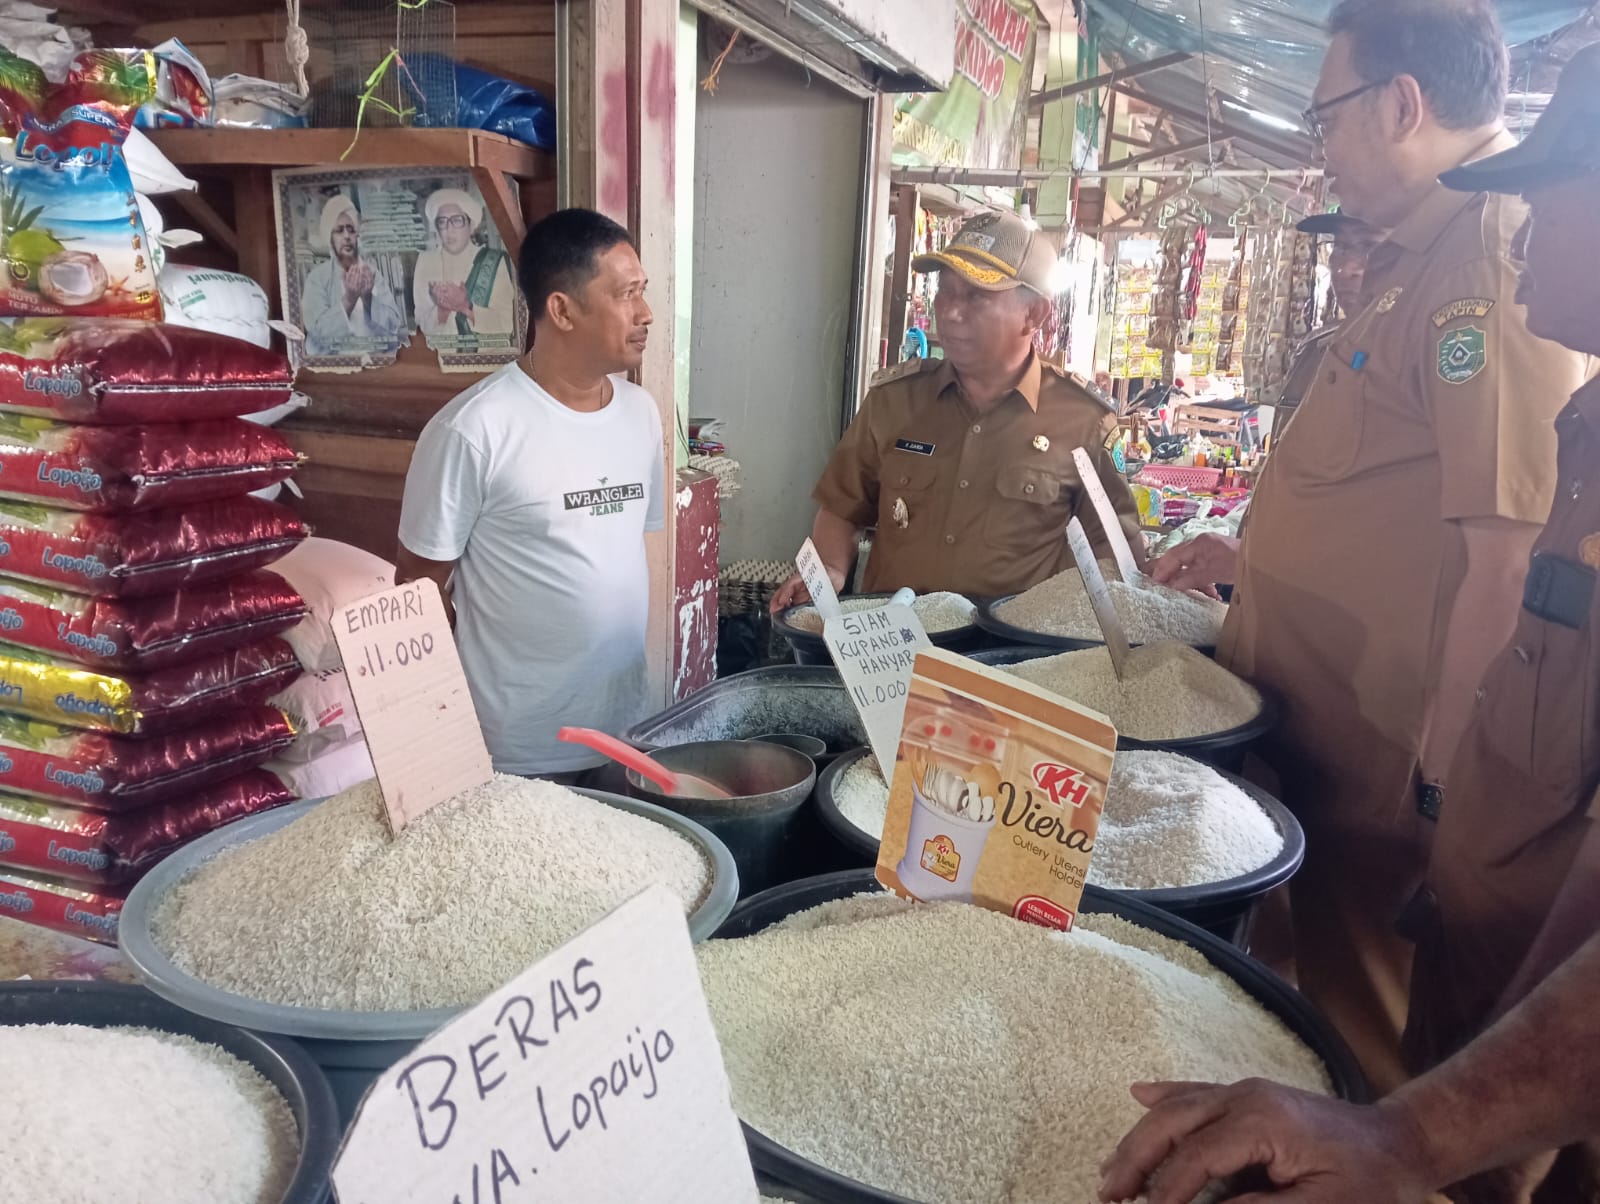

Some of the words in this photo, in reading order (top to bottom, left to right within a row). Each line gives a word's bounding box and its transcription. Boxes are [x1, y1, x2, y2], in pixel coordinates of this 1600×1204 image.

[566, 485, 643, 508] WRANGLER
[589, 502, 624, 516] JEANS
[843, 611, 891, 636] SIAM
[853, 680, 906, 708] 11.000
[1032, 762, 1092, 806] KH
[998, 781, 1094, 853] Viera
[1012, 834, 1050, 861] Cutlery
[1054, 855, 1087, 879] Utensi
[396, 957, 602, 1151] BERAS
